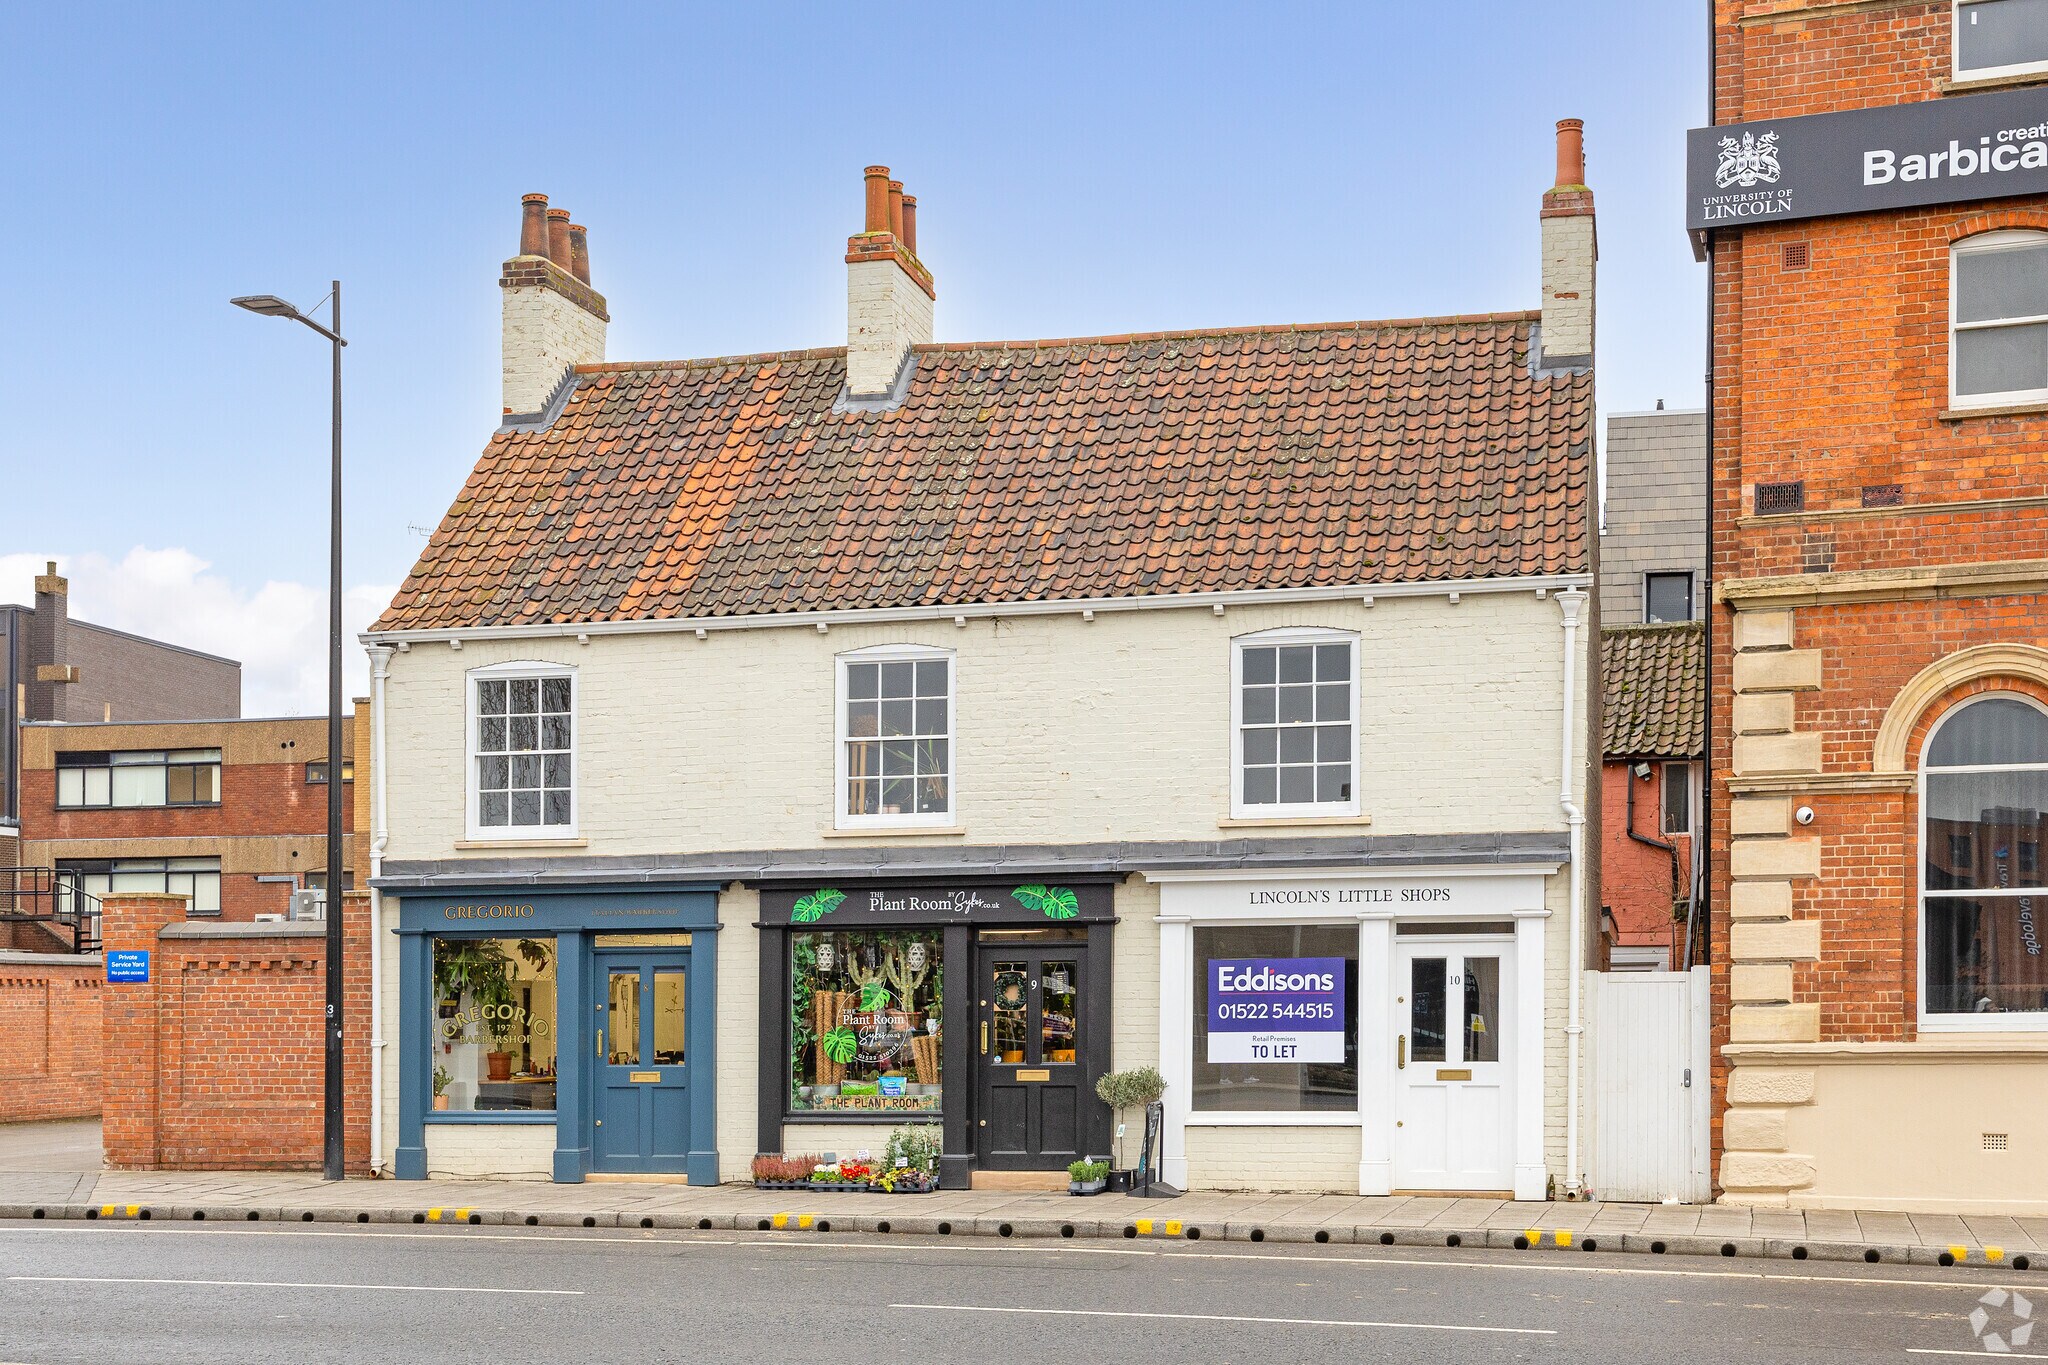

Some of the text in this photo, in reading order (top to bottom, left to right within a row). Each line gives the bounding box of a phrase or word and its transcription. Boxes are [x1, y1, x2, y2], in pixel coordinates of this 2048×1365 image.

[1864, 136, 2047, 186] Barbica
[1703, 188, 1793, 205] UNIVERSITY OF
[1703, 198, 1792, 220] LINCOLN
[1250, 888, 1451, 904] LINCOLN'S LITTLE SHOPS
[869, 897, 952, 911] Plant Room
[444, 904, 534, 920] GREGORIO
[1031, 980, 1037, 990] 9
[1218, 966, 1334, 992] Eddisons
[1449, 975, 1461, 985] 10
[1218, 1003, 1334, 1019] 01522 544515
[442, 1004, 549, 1037] GREGORIO
[842, 1014, 905, 1025] Plant Room
[497, 1024, 517, 1032] 1979
[460, 1035, 533, 1044] BARBERSHOP
[1252, 1045, 1297, 1058] TO LET
[831, 1098, 919, 1108] THE PLANT ROOM
